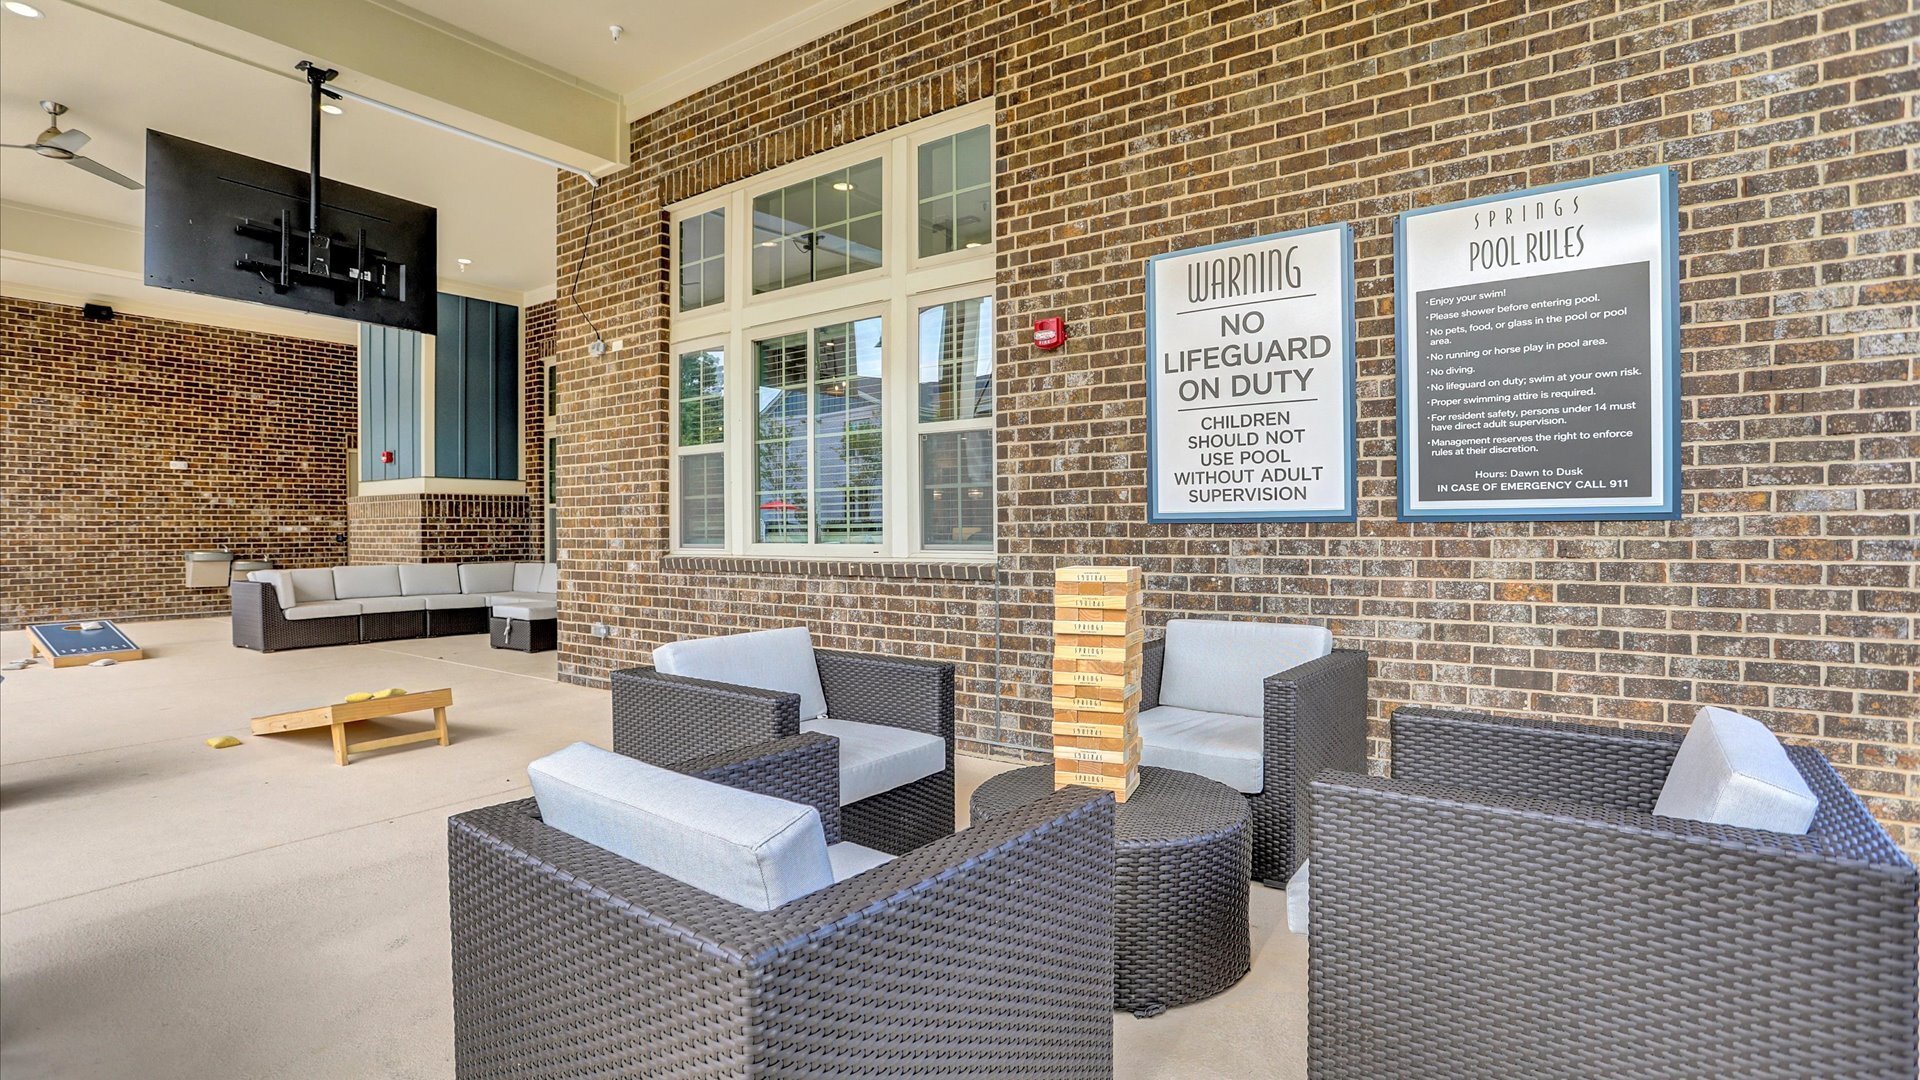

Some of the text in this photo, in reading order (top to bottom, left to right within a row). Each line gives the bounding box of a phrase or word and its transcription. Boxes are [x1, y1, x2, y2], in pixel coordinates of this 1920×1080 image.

[1474, 196, 1578, 230] SPRINGS
[1470, 224, 1584, 271] POOL RULES
[1187, 246, 1301, 303] WARNING
[1430, 289, 1506, 306] Enjoy your swim!
[1430, 293, 1600, 321] Please shower before entering pool.
[1221, 311, 1265, 338] NO
[1430, 307, 1627, 336] No pets, food, or glass in the pool or pool
[1430, 338, 1452, 346] area.
[1430, 353, 1443, 361] No
[1446, 350, 1480, 360] running
[1495, 346, 1521, 355] horse
[1523, 343, 1544, 353] play
[1546, 341, 1555, 350] in
[1557, 339, 1580, 350] pool
[1582, 338, 1608, 347] area.
[1164, 334, 1332, 374] LIFEGUARD
[1430, 366, 1475, 376] No diving.
[1430, 367, 1642, 391] No lifeguard on duty; swim at your own risk.
[1178, 367, 1314, 401] ON DUTY
[1431, 387, 1596, 407] Proper swimming attire is required.
[1200, 411, 1290, 431] CHILDREN
[1431, 401, 1637, 422] For resident safety, persons under 14 must
[1431, 417, 1567, 431] have direct adult supervision.
[1187, 429, 1306, 449] SHOULD NOT
[1431, 429, 1633, 447] Management reserves the right to enforce
[1200, 449, 1291, 467] USE POOL
[1431, 444, 1538, 456] rules at their discretion.
[1174, 466, 1324, 486] WITHOUT ADULT
[1475, 467, 1584, 479] Hours: Dawn to Dusk
[1188, 486, 1307, 503] SUPERVISION
[1437, 479, 1628, 493] IN CASE OF EMERGENCY CALL 911
[1073, 699, 1102, 707] SPRINGS
